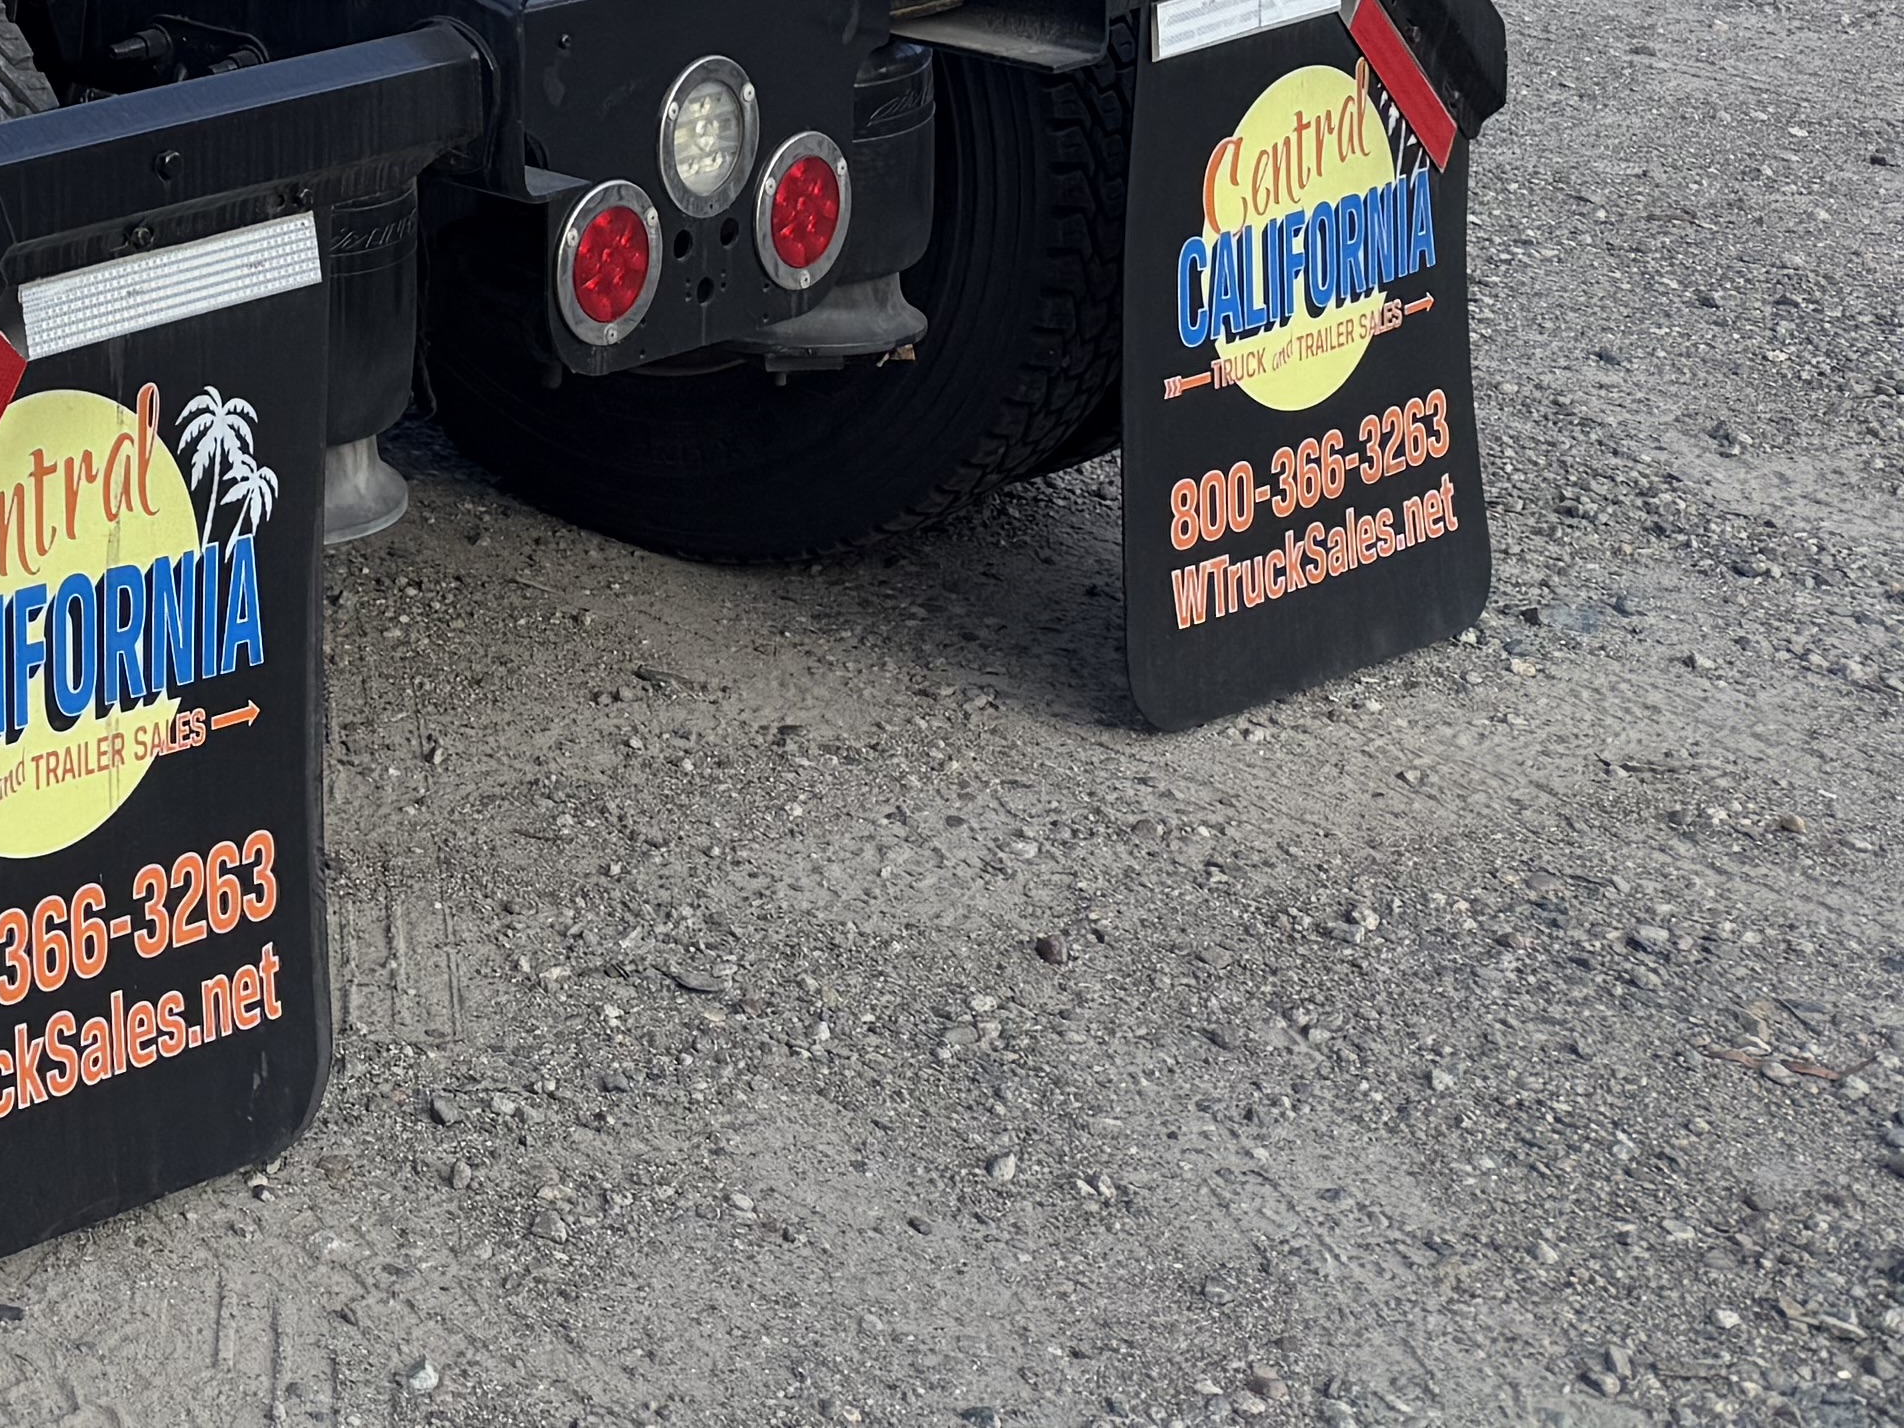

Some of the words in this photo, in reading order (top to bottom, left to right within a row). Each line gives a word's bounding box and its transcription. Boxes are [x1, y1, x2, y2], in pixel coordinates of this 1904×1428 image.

[1203, 56, 1371, 237] Central
[1177, 168, 1436, 349] CALIFORNIA
[1210, 347, 1267, 390] TRUCK
[1271, 335, 1295, 372] and
[1296, 321, 1355, 362] TRAILER
[1359, 298, 1404, 338] SALES
[1170, 388, 1450, 551] 800-366-3263
[1171, 472, 1459, 630] WTruckSales.net
[30, 729, 125, 791] TRAILER
[134, 707, 207, 762] SALES
